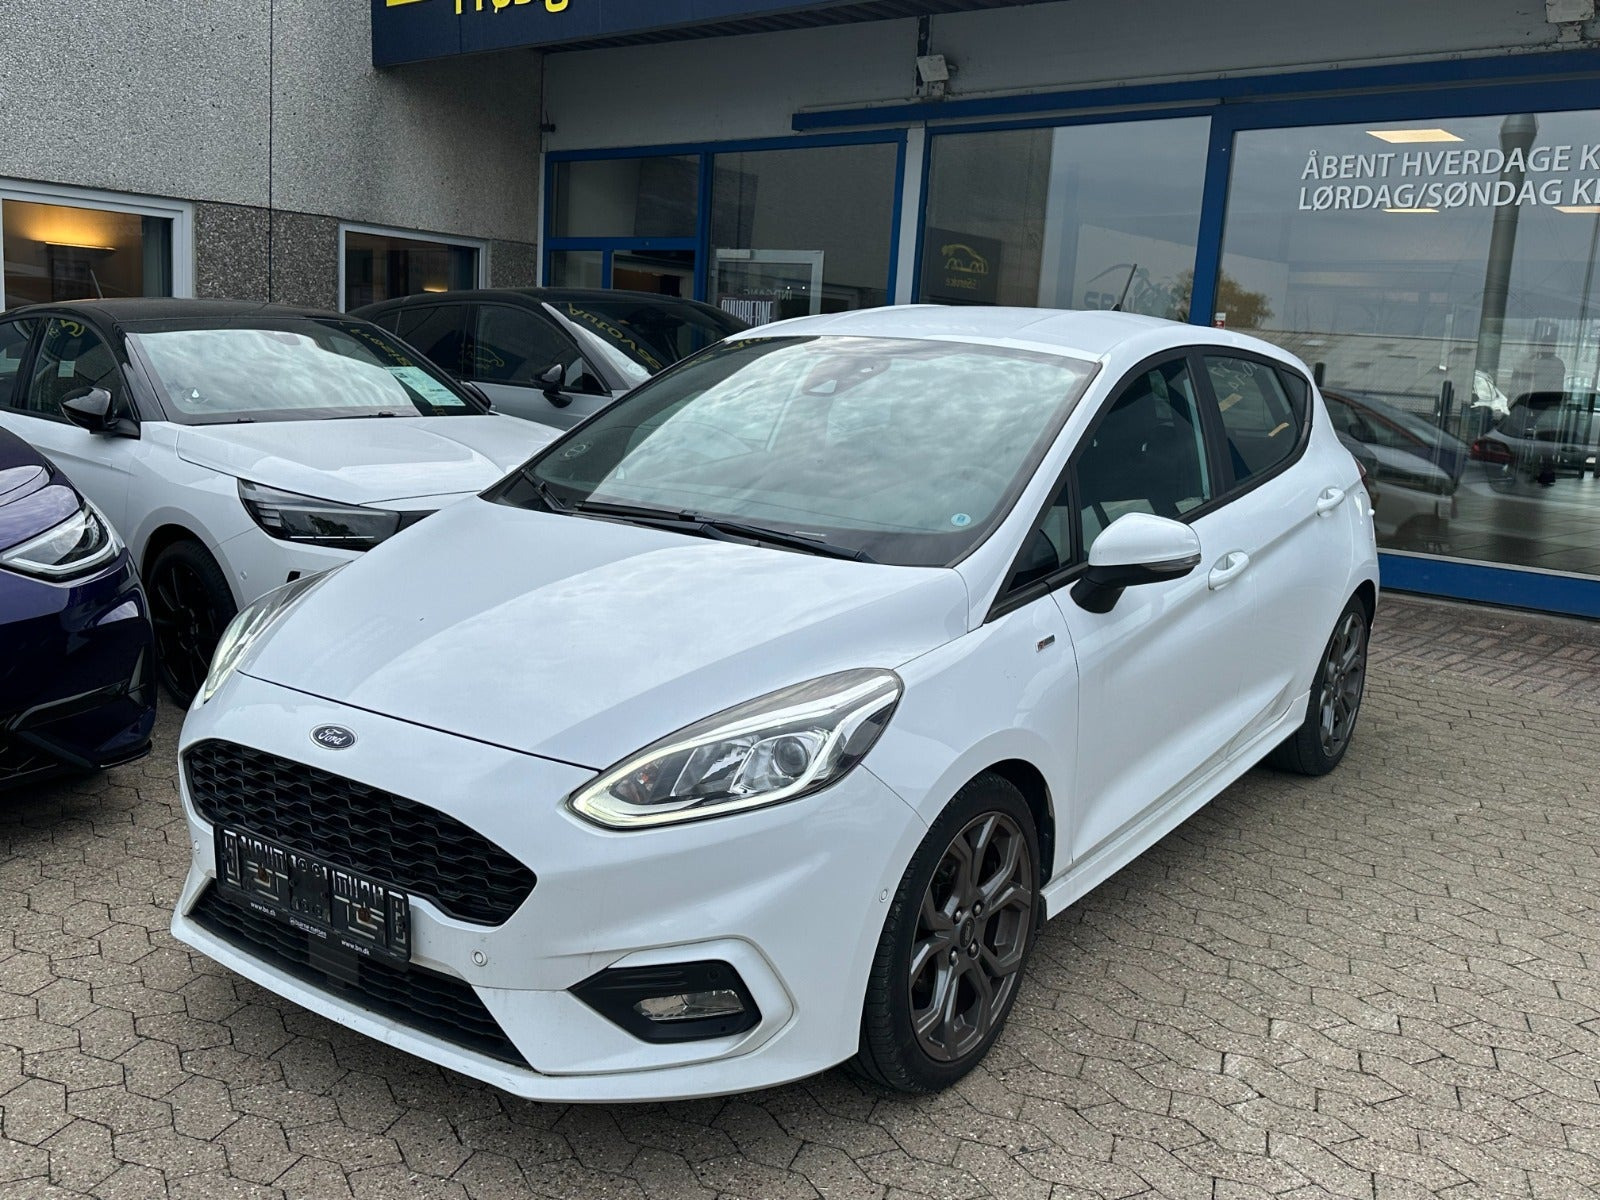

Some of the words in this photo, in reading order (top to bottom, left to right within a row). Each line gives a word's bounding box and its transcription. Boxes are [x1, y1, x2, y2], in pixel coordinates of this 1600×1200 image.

[1301, 150, 1396, 179] ÅBENT
[1401, 145, 1572, 176] HVERDAGE
[1299, 180, 1562, 211] LØRDAG/SØNDAG
[318, 728, 347, 745] Ford
